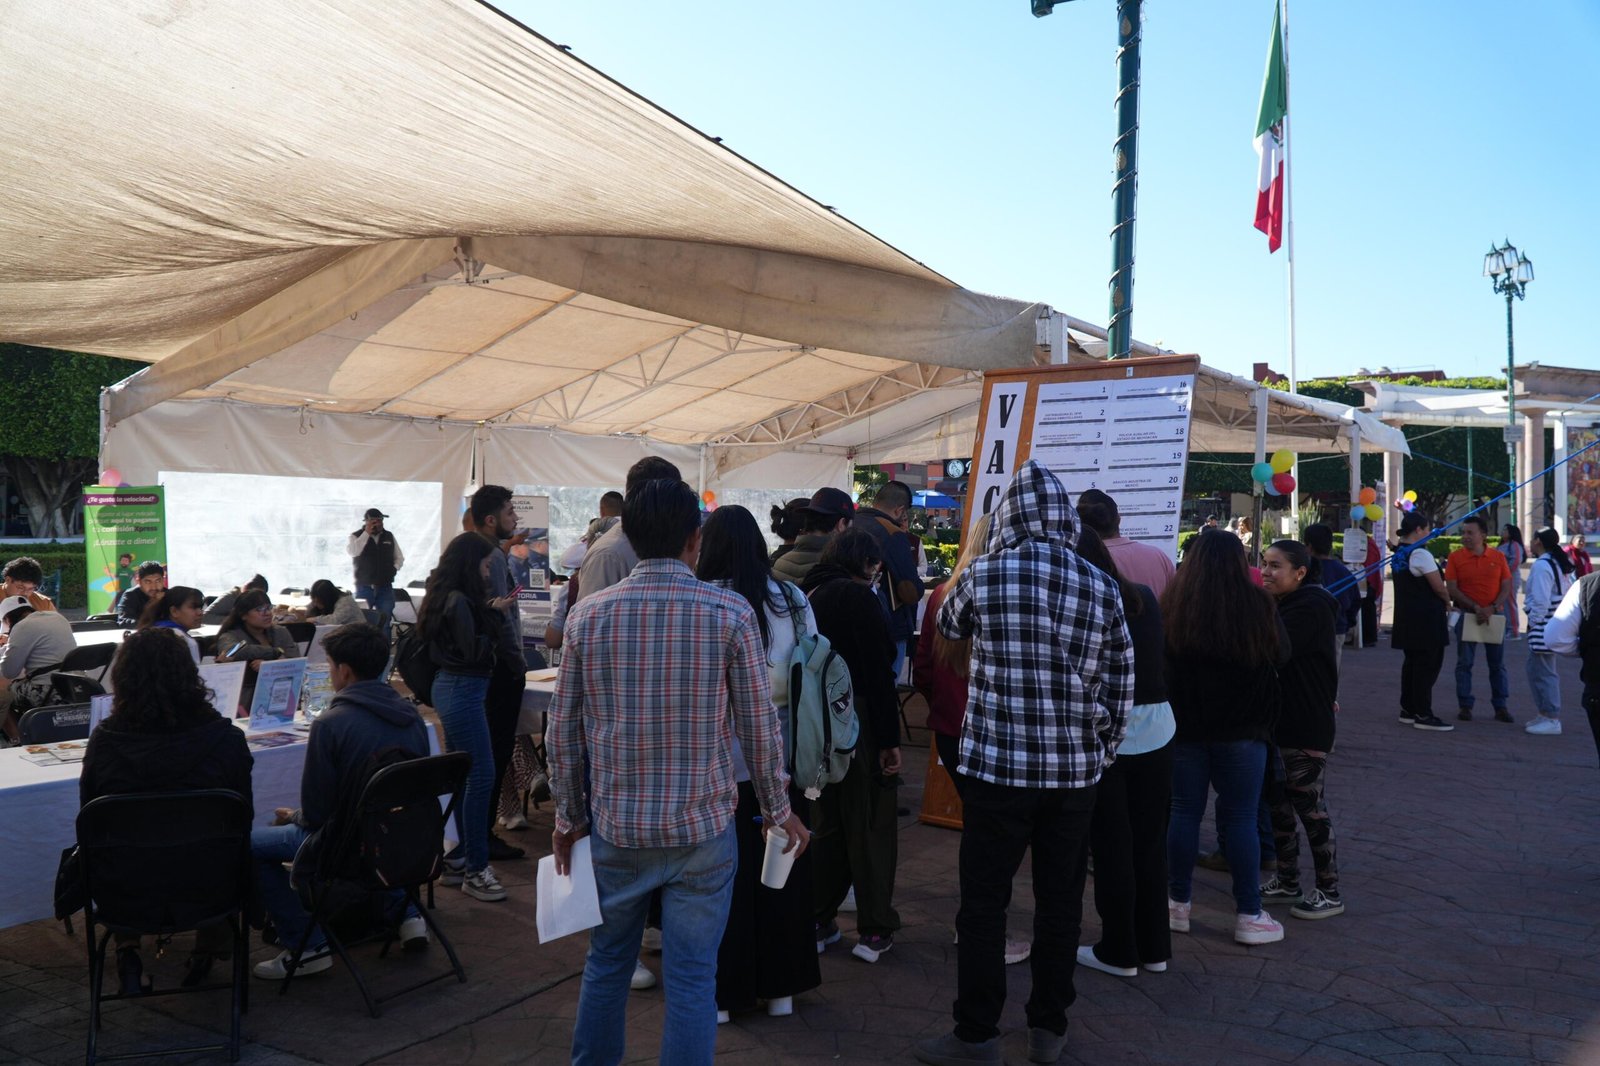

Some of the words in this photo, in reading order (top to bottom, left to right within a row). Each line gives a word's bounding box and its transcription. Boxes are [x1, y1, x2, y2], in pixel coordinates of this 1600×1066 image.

[1168, 476, 1178, 484] 20
[1166, 501, 1176, 509] 21
[1164, 524, 1174, 532] 22
[133, 537, 157, 545] dimex!
